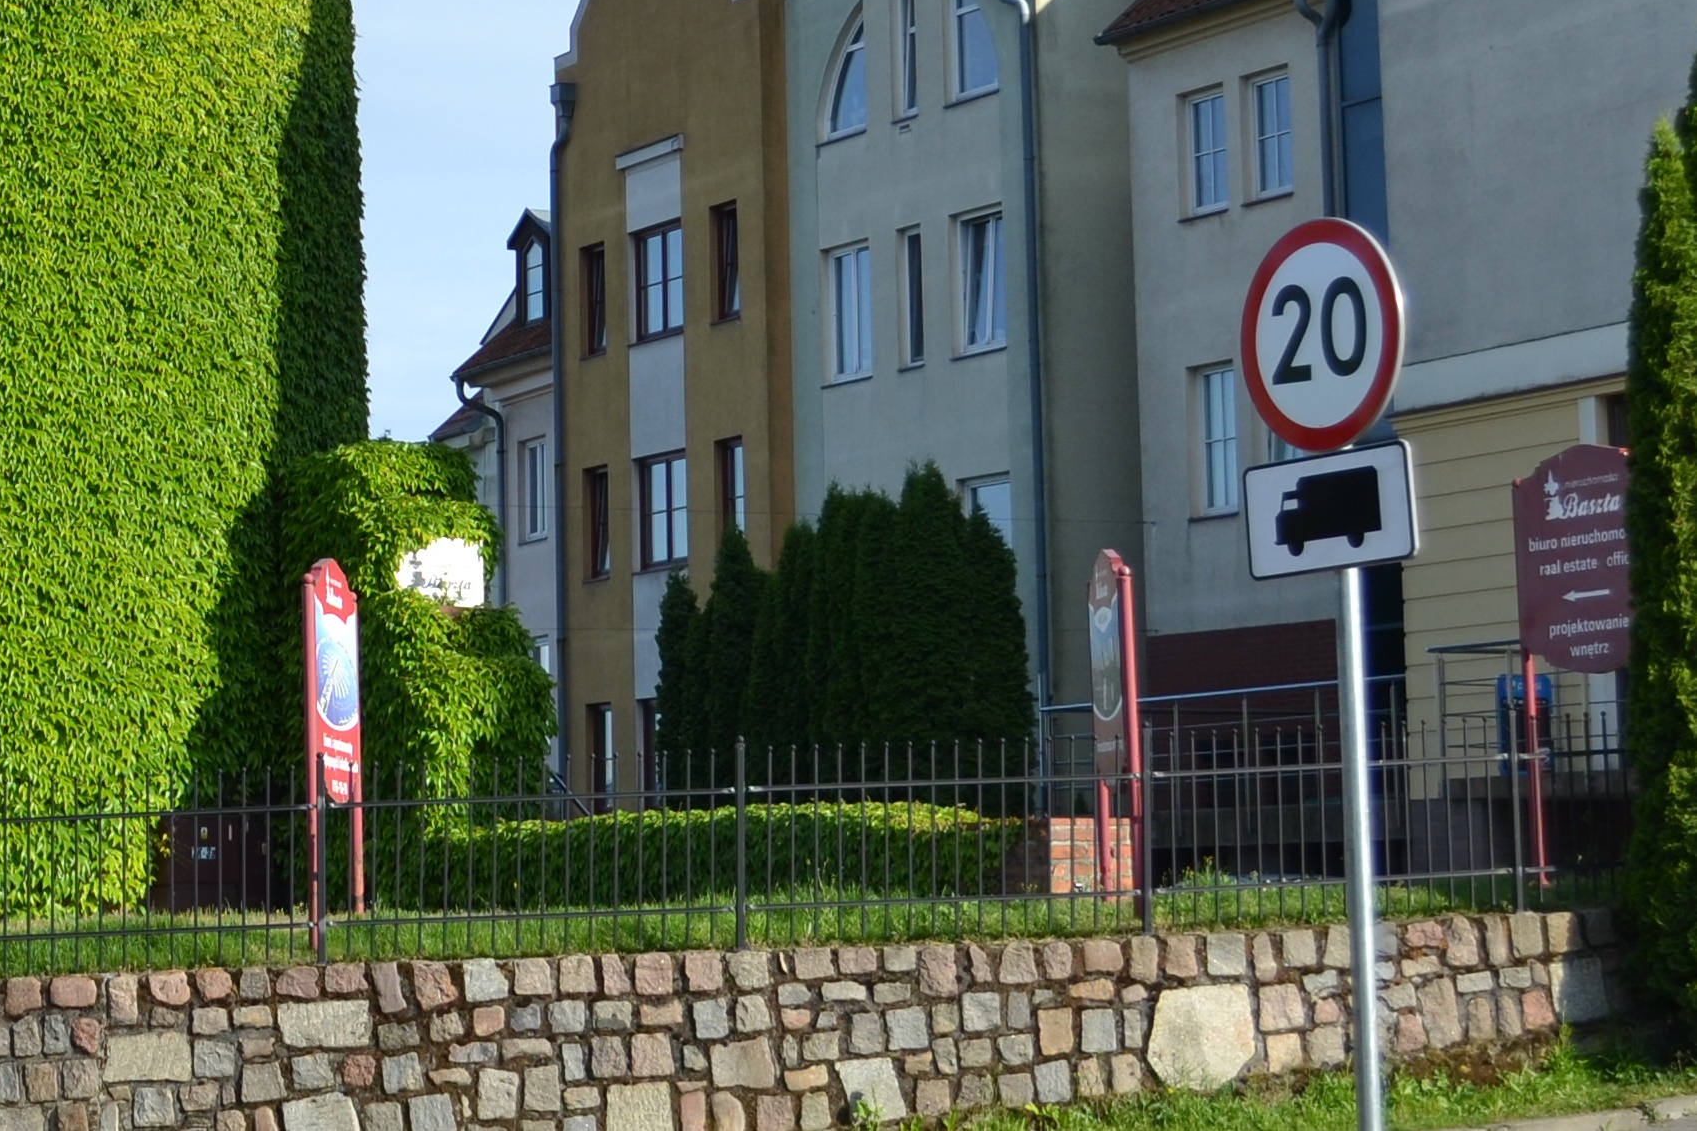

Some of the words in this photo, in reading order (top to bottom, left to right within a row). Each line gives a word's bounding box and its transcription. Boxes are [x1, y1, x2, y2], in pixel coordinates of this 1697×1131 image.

[1272, 276, 1367, 385] 20
[1560, 492, 1621, 520] Baszta
[1528, 536, 1558, 552] biuro
[1563, 557, 1598, 573] estate
[1549, 613, 1630, 639] projektowanie
[1569, 642, 1609, 659] wnętrz
